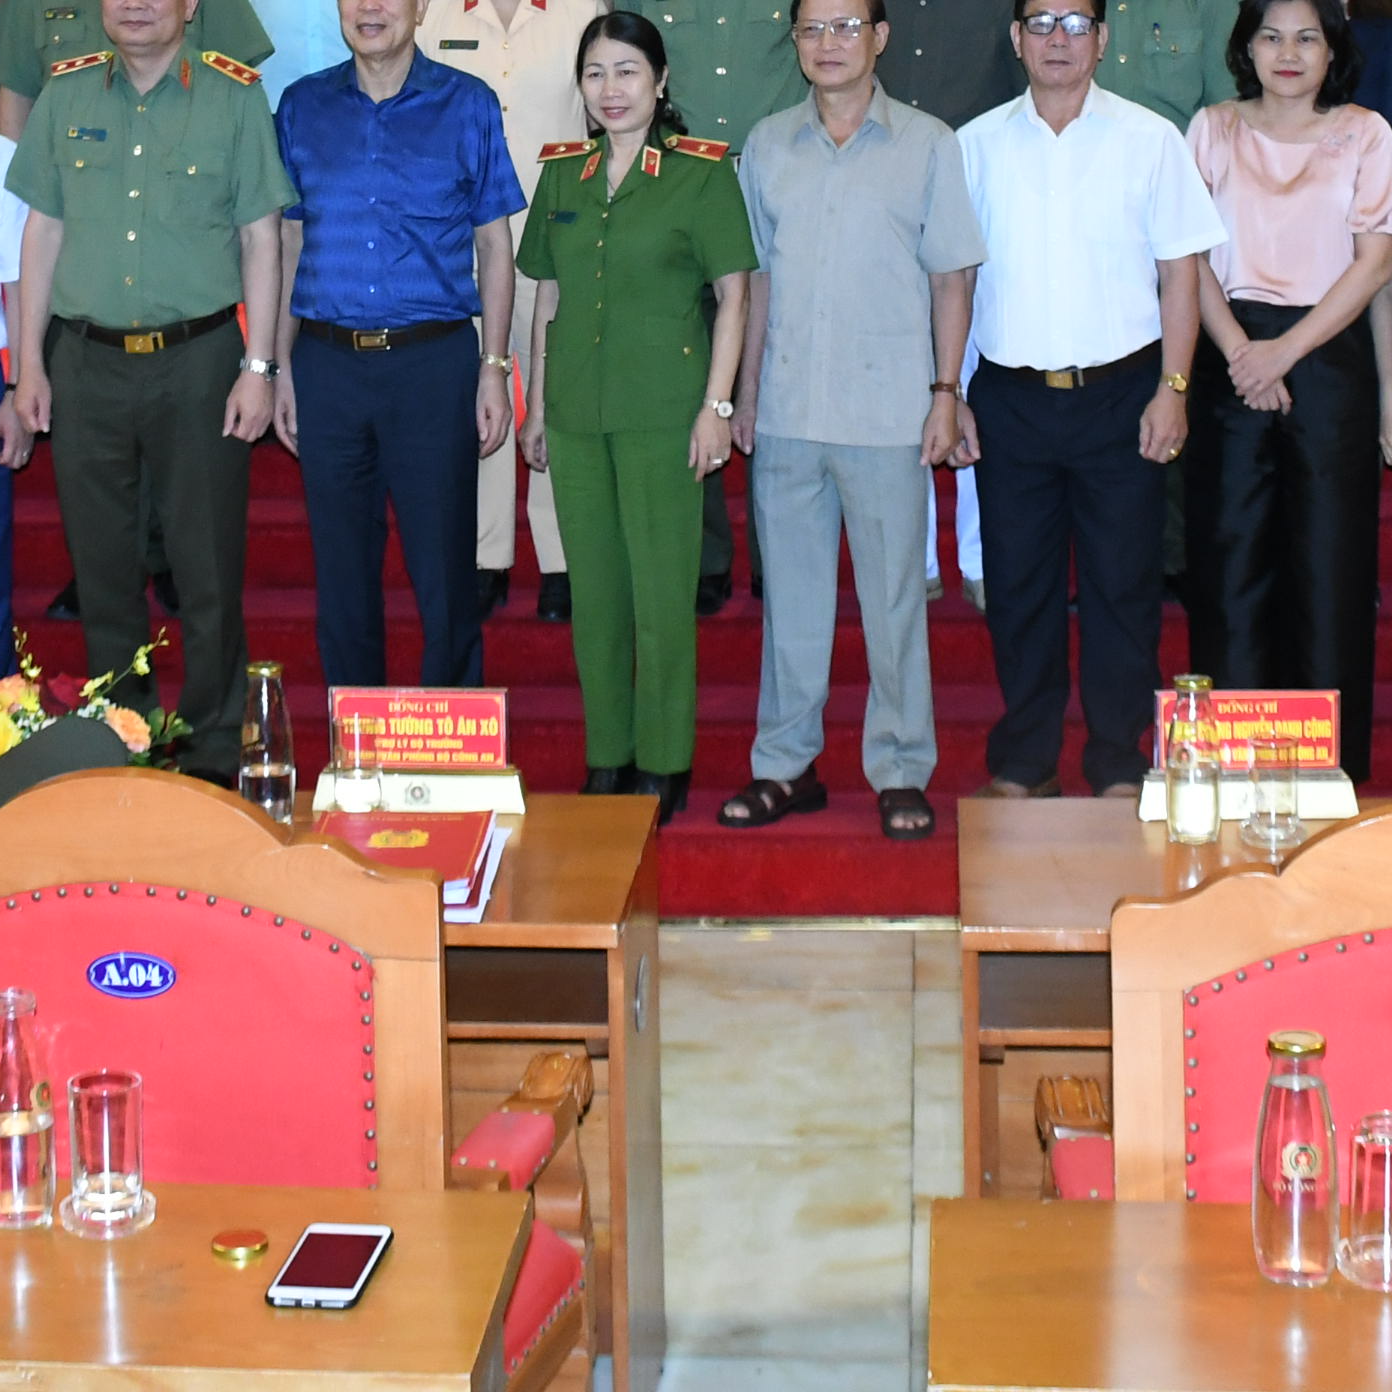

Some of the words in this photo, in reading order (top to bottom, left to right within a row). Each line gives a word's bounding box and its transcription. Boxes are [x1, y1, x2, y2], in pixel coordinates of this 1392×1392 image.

[389, 700, 423, 713] ĐỒNG
[426, 700, 448, 713] CHÍ
[1217, 700, 1253, 713] ĐỒNG
[1256, 700, 1277, 713] CHÍ
[343, 717, 386, 735] TRUNG
[389, 714, 433, 736] TƯỚNG
[437, 716, 454, 736] TÔ
[457, 715, 476, 736] ÂN
[480, 715, 498, 737] XÔ
[101, 961, 163, 987] A.04
